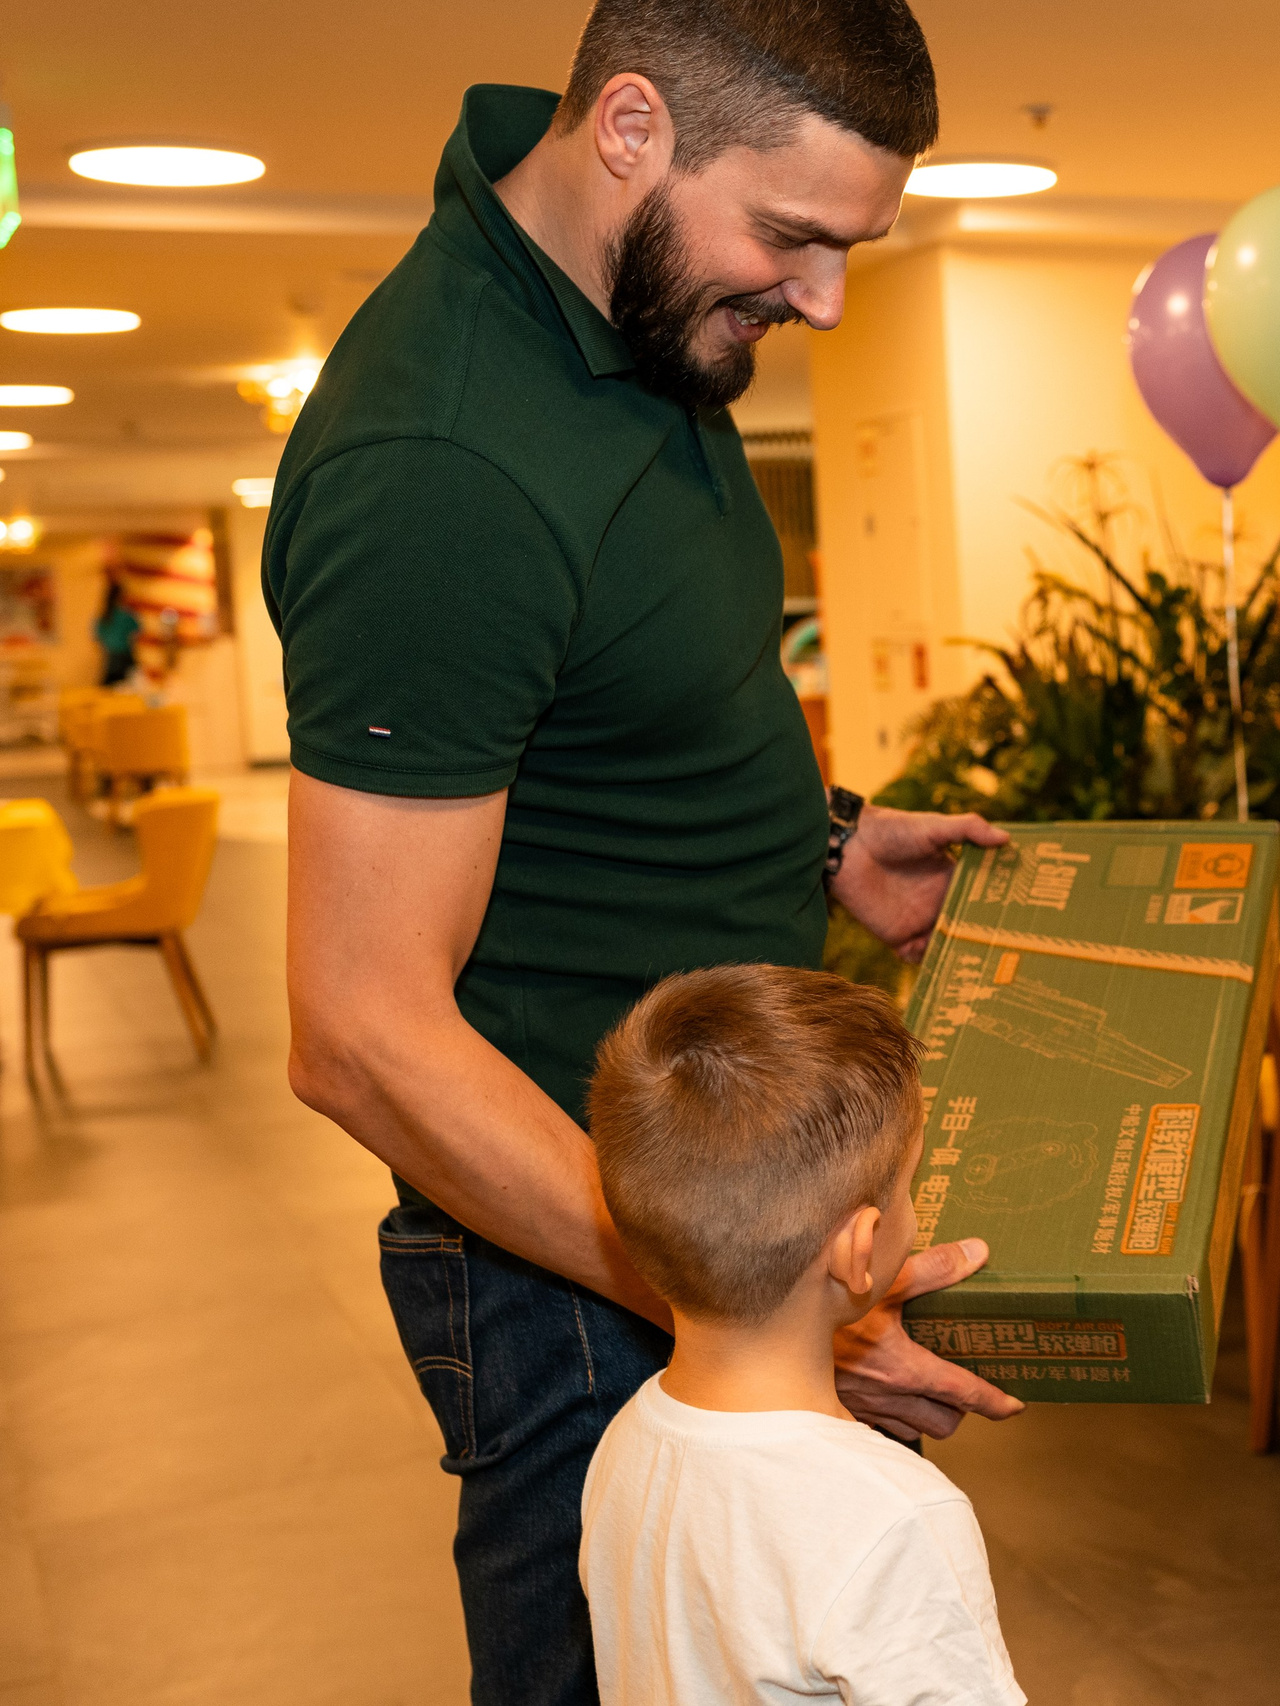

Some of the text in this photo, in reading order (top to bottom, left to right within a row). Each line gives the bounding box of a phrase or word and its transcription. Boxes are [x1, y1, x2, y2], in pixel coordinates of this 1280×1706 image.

[1138, 1108, 1194, 1200] 科教模型
[902, 1323, 1118, 1355] 教模型 软弹枪
[964, 1364, 1131, 1382] 版授权/军事题材
